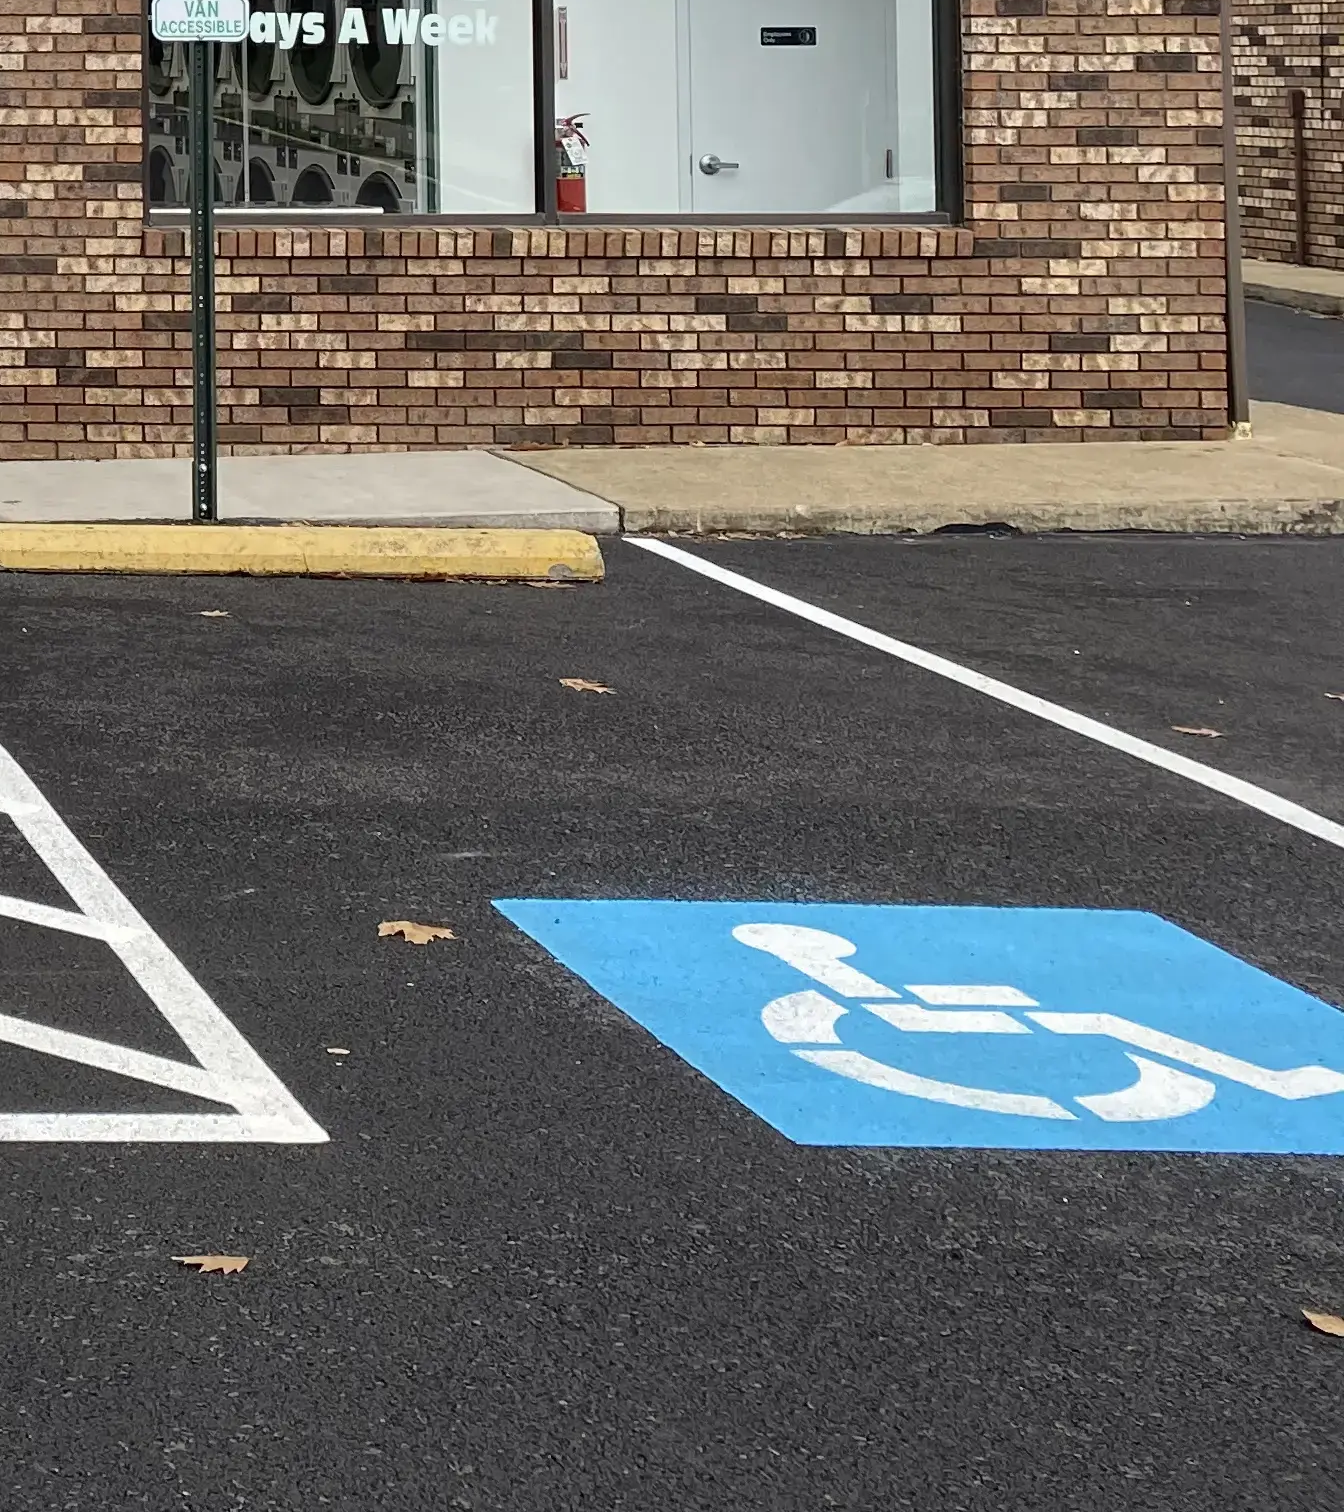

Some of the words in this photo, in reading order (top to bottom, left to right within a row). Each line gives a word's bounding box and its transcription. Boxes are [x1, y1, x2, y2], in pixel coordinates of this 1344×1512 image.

[184, 0, 219, 18] VAN
[160, 20, 242, 34] ACCESSIBLE
[249, 10, 325, 50] ays
[338, 7, 369, 44] A
[381, 8, 500, 46] Week
